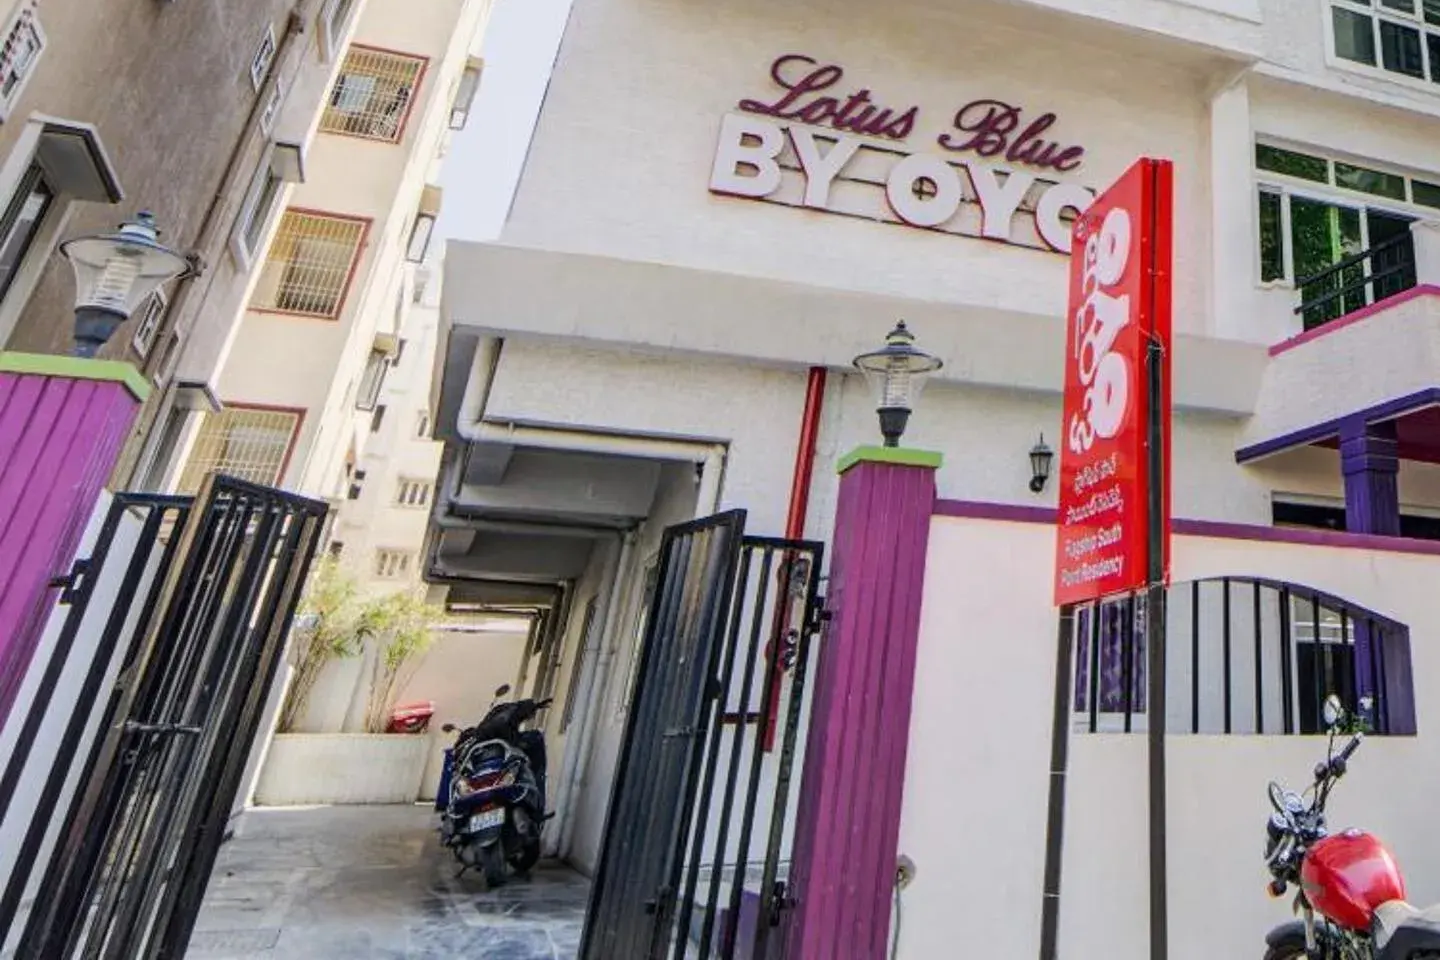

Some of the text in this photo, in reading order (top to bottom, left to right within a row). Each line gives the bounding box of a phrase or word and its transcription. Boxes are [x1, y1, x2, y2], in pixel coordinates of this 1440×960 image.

[708, 112, 862, 208] BY
[739, 54, 1085, 171] Lotus Blue
[1091, 207, 1131, 438] OYO
